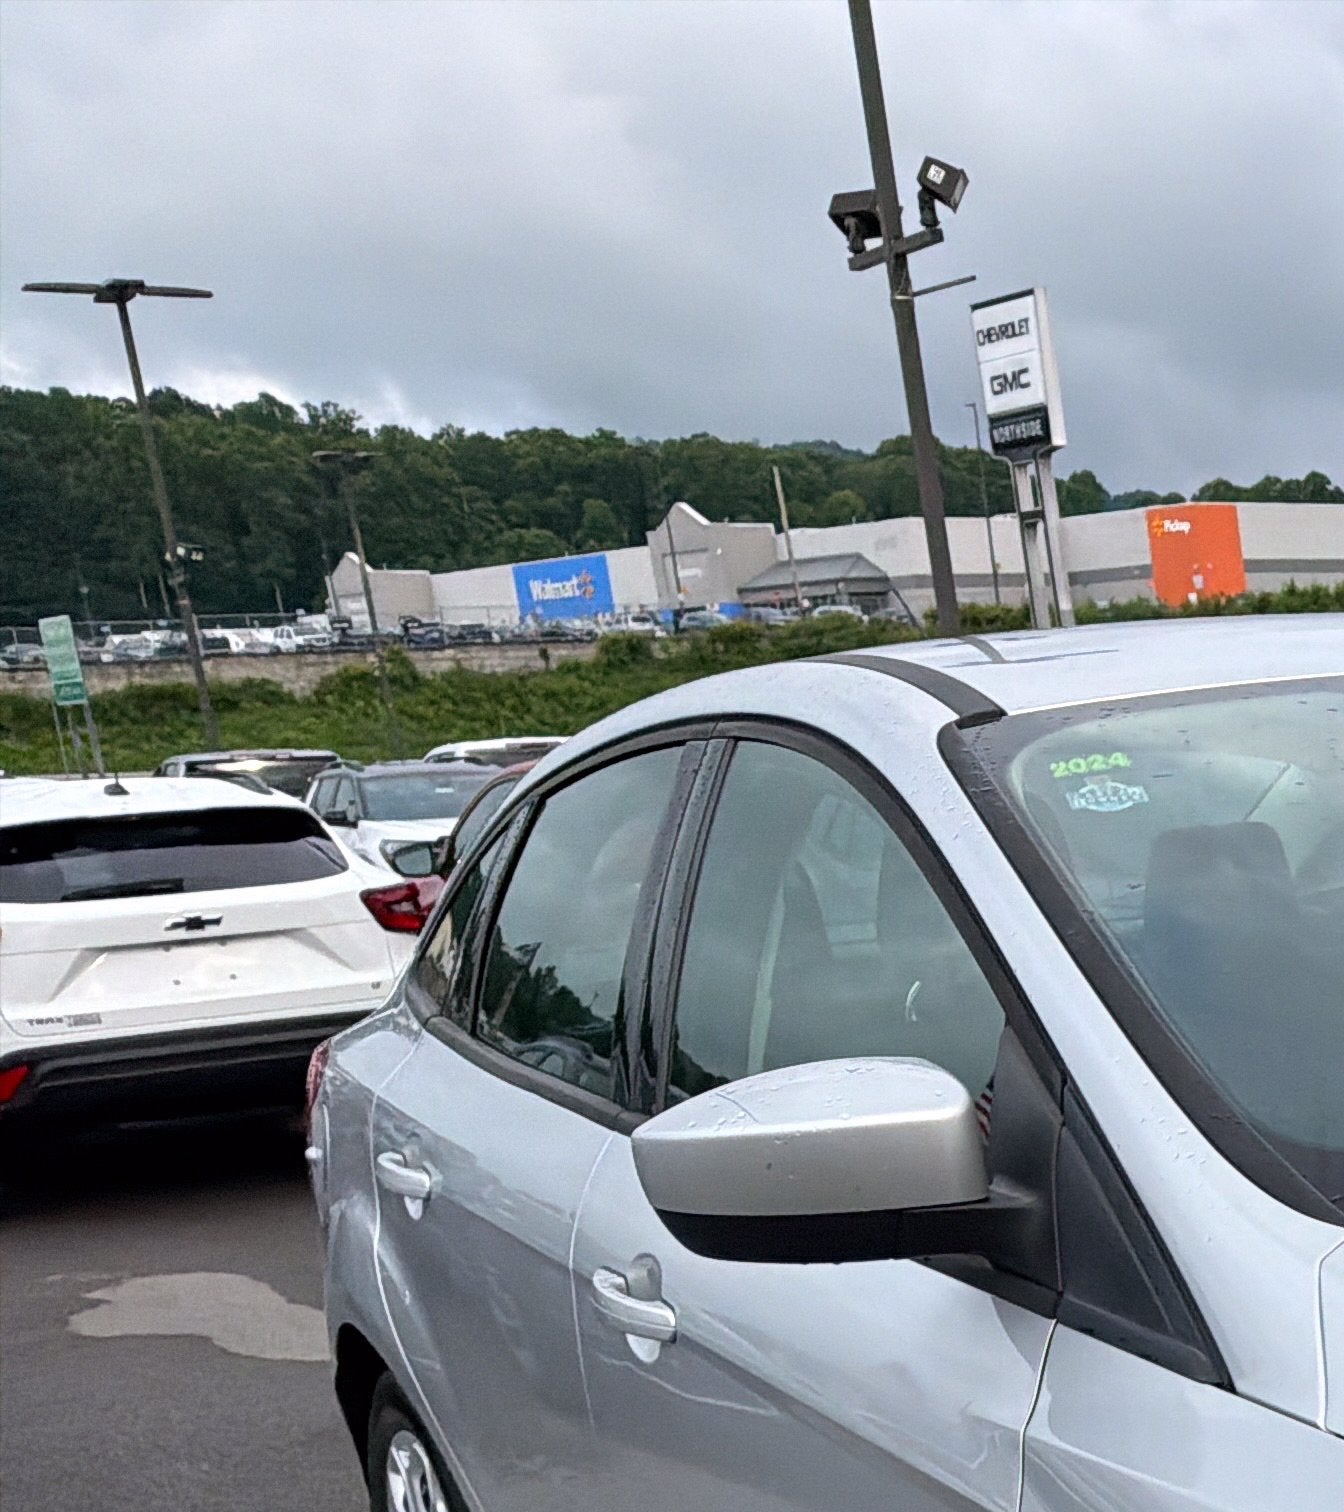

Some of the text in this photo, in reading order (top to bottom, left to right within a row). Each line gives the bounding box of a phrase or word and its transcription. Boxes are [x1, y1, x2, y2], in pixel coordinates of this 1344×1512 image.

[975, 317, 1030, 346] CHEVROLET
[990, 367, 1031, 396] GMC
[993, 418, 1044, 444] NORTHSIDE
[1163, 518, 1191, 536] Pickup
[528, 574, 581, 601] Walmart
